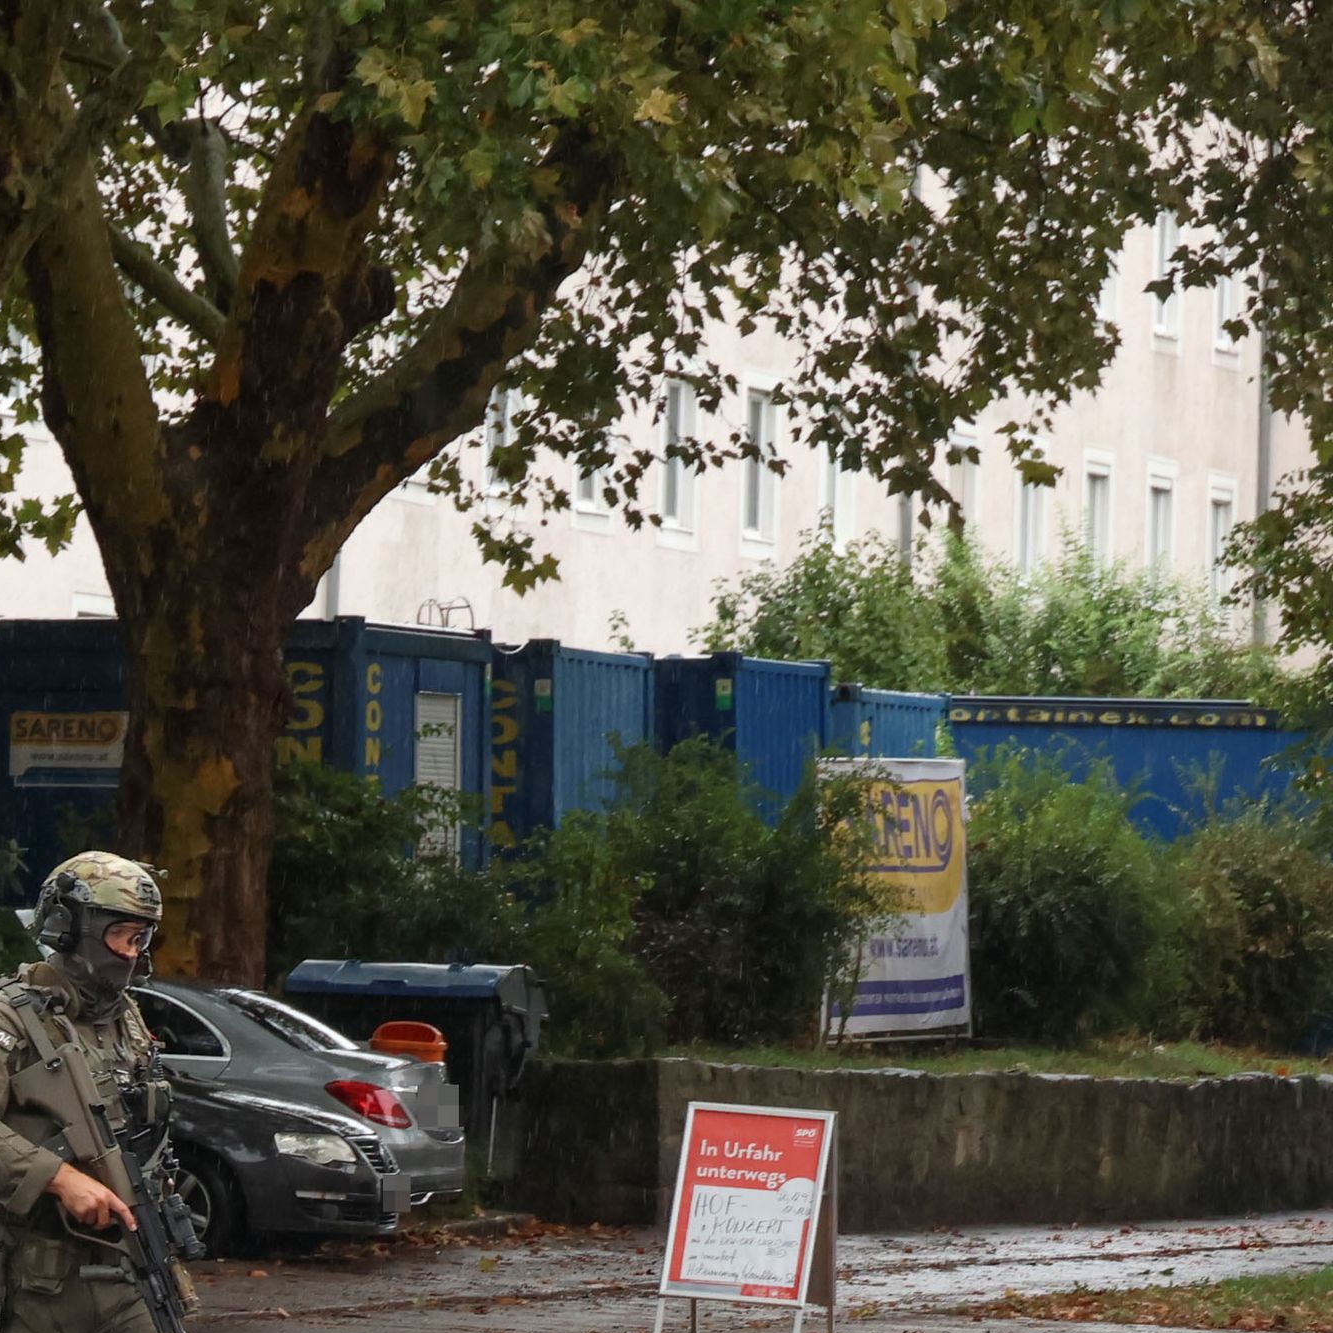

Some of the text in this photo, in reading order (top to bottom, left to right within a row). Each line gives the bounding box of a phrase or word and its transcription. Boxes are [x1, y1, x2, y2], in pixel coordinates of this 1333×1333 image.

[15, 717, 119, 742] SARENO
[794, 1127, 817, 1138] SPÖ
[699, 1139, 718, 1158] In
[724, 1141, 784, 1162] Urfahr
[696, 1165, 787, 1190] unterwegs
